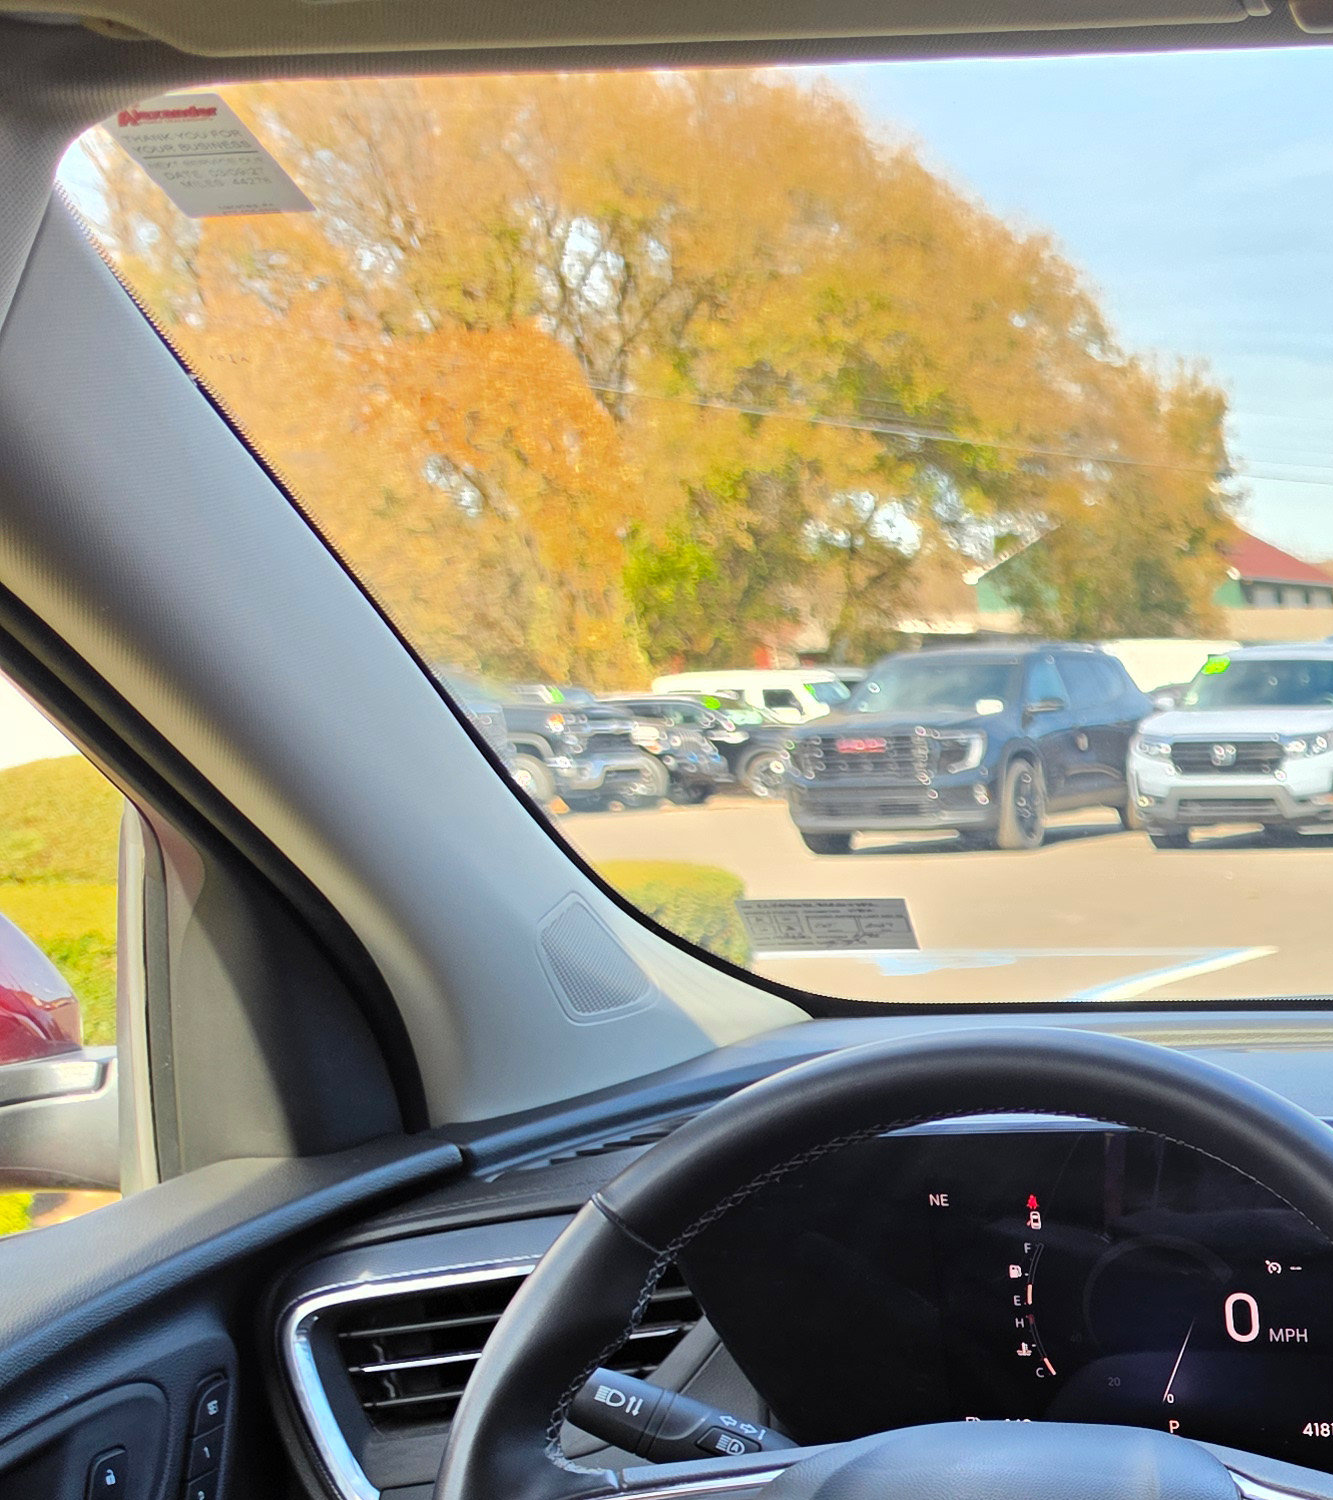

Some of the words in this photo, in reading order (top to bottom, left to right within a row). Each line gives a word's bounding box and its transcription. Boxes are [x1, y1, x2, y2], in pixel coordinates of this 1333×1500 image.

[174, 130, 209, 142] YOU
[211, 129, 243, 139] FOR
[177, 140, 252, 153] BUSINESS
[929, 1194, 949, 1207] NE
[1013, 1296, 1022, 1306] E
[1015, 1318, 1025, 1329] H
[1224, 1292, 1260, 1343] 0
[1269, 1328, 1309, 1344] MPH
[1035, 1367, 1045, 1379] C
[1107, 1377, 1121, 1387] 20
[1169, 1420, 1180, 1434] P
